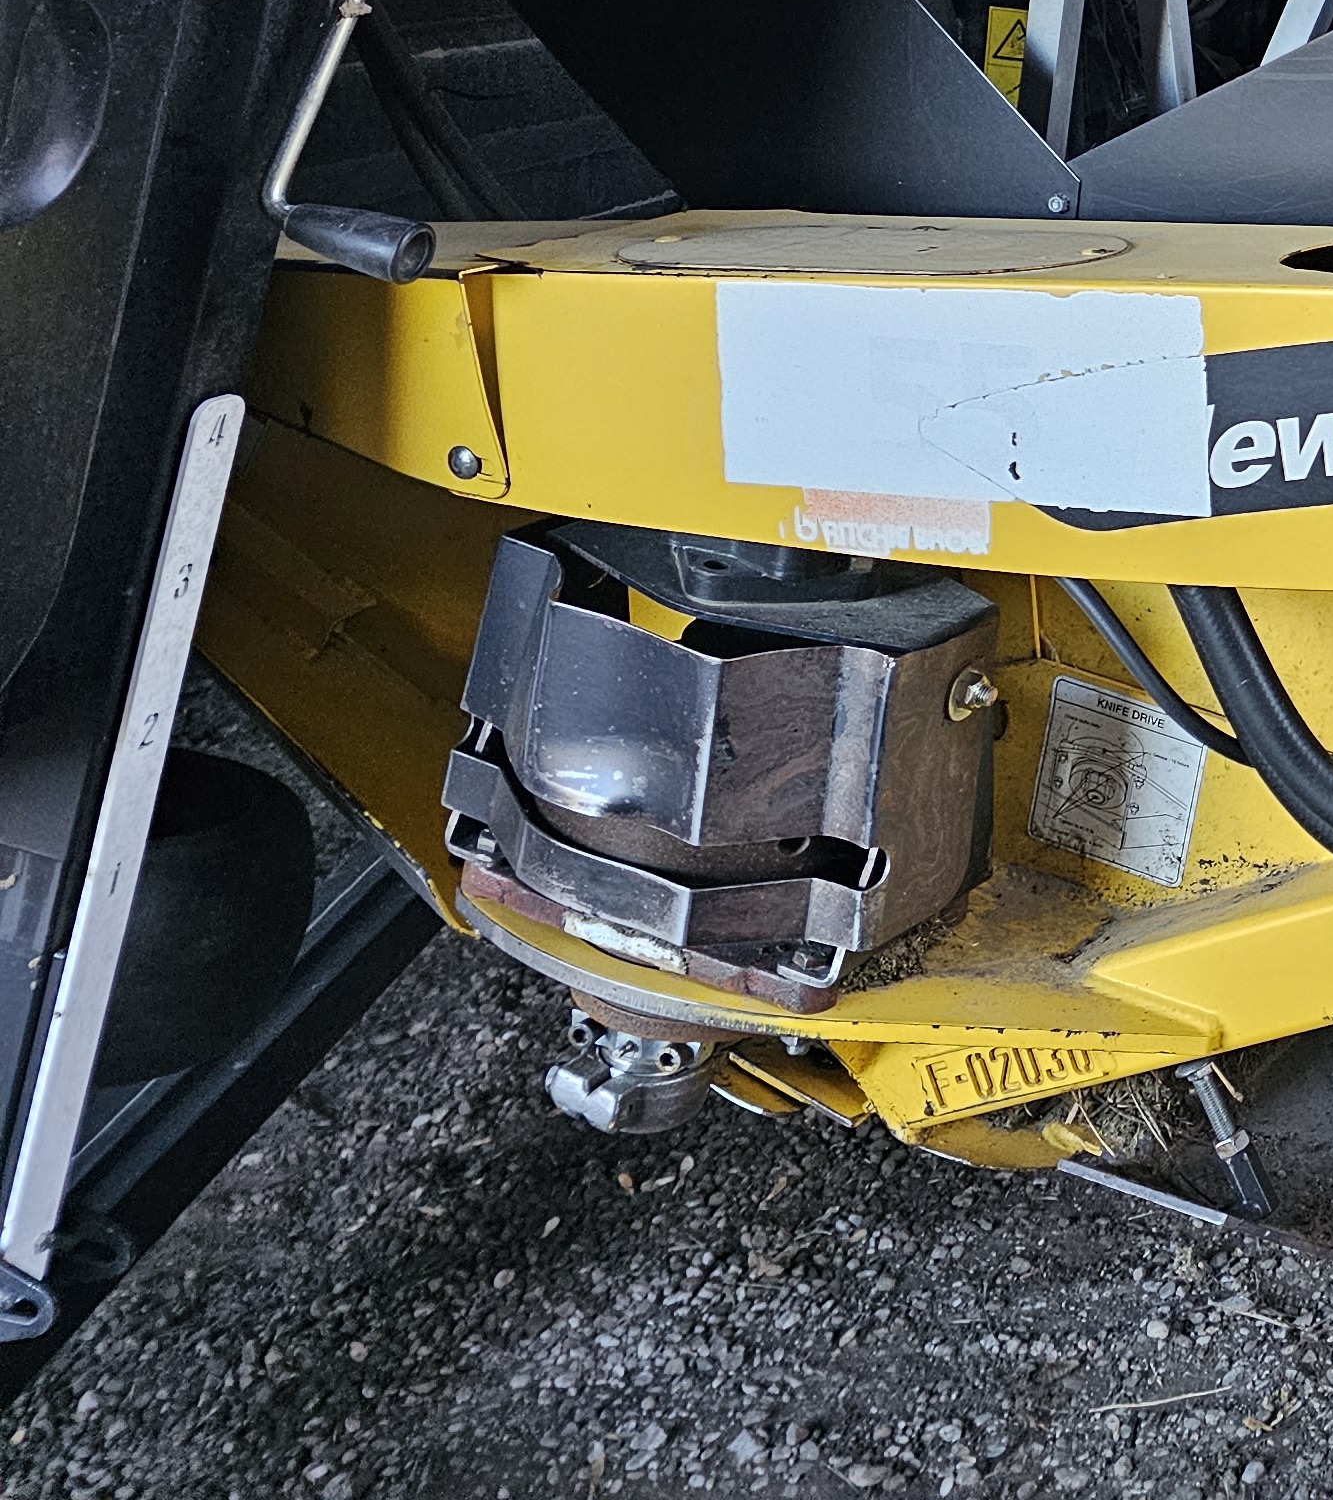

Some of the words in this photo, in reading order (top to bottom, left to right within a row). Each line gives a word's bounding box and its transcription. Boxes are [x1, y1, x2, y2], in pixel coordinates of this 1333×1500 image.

[207, 414, 227, 448] 4
[174, 562, 193, 600] 3
[138, 713, 159, 750] 2
[1096, 698, 1129, 717] KNIFE
[1131, 710, 1165, 729] DRIVE
[109, 861, 122, 897] 1
